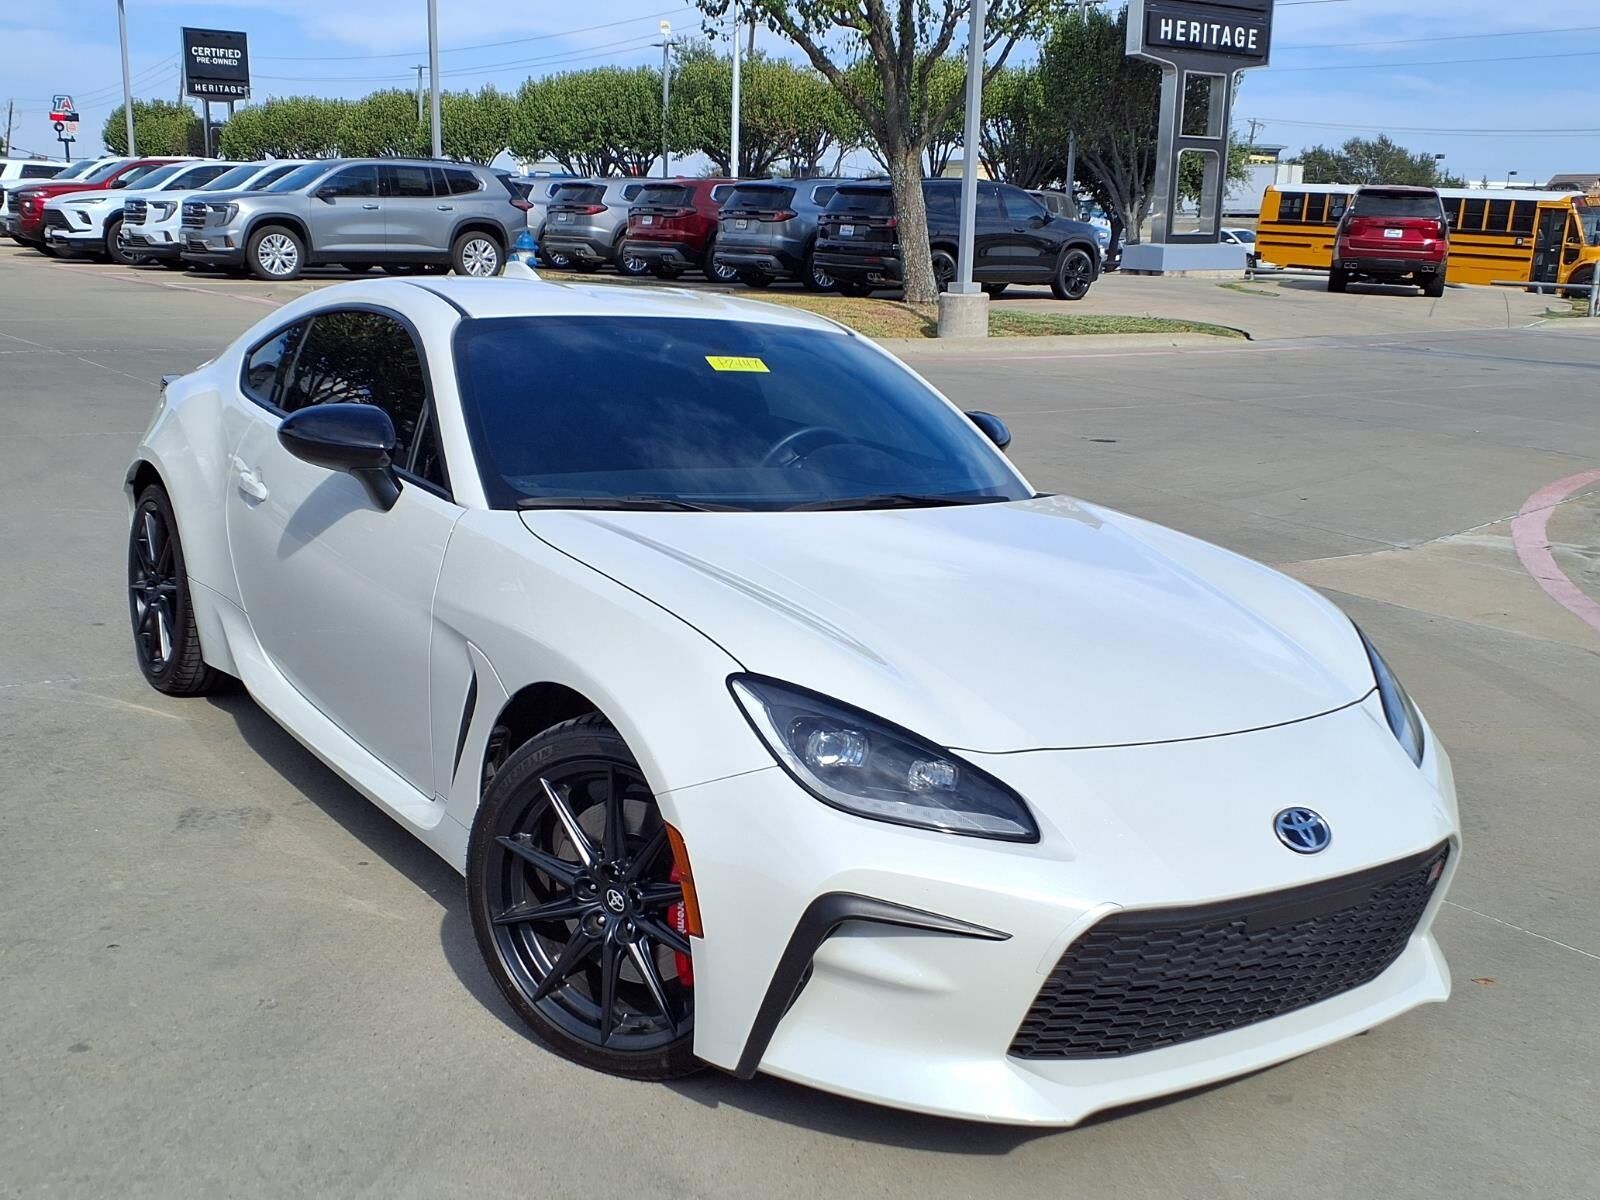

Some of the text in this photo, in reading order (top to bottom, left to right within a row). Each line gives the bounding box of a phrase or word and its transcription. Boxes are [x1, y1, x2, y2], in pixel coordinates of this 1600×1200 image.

[1160, 18, 1258, 49] HERITAGE
[191, 46, 242, 59] CERTIFIED
[196, 56, 238, 66] PRE-OWNED
[194, 83, 243, 94] HERITAGE
[54, 96, 73, 111] TA
